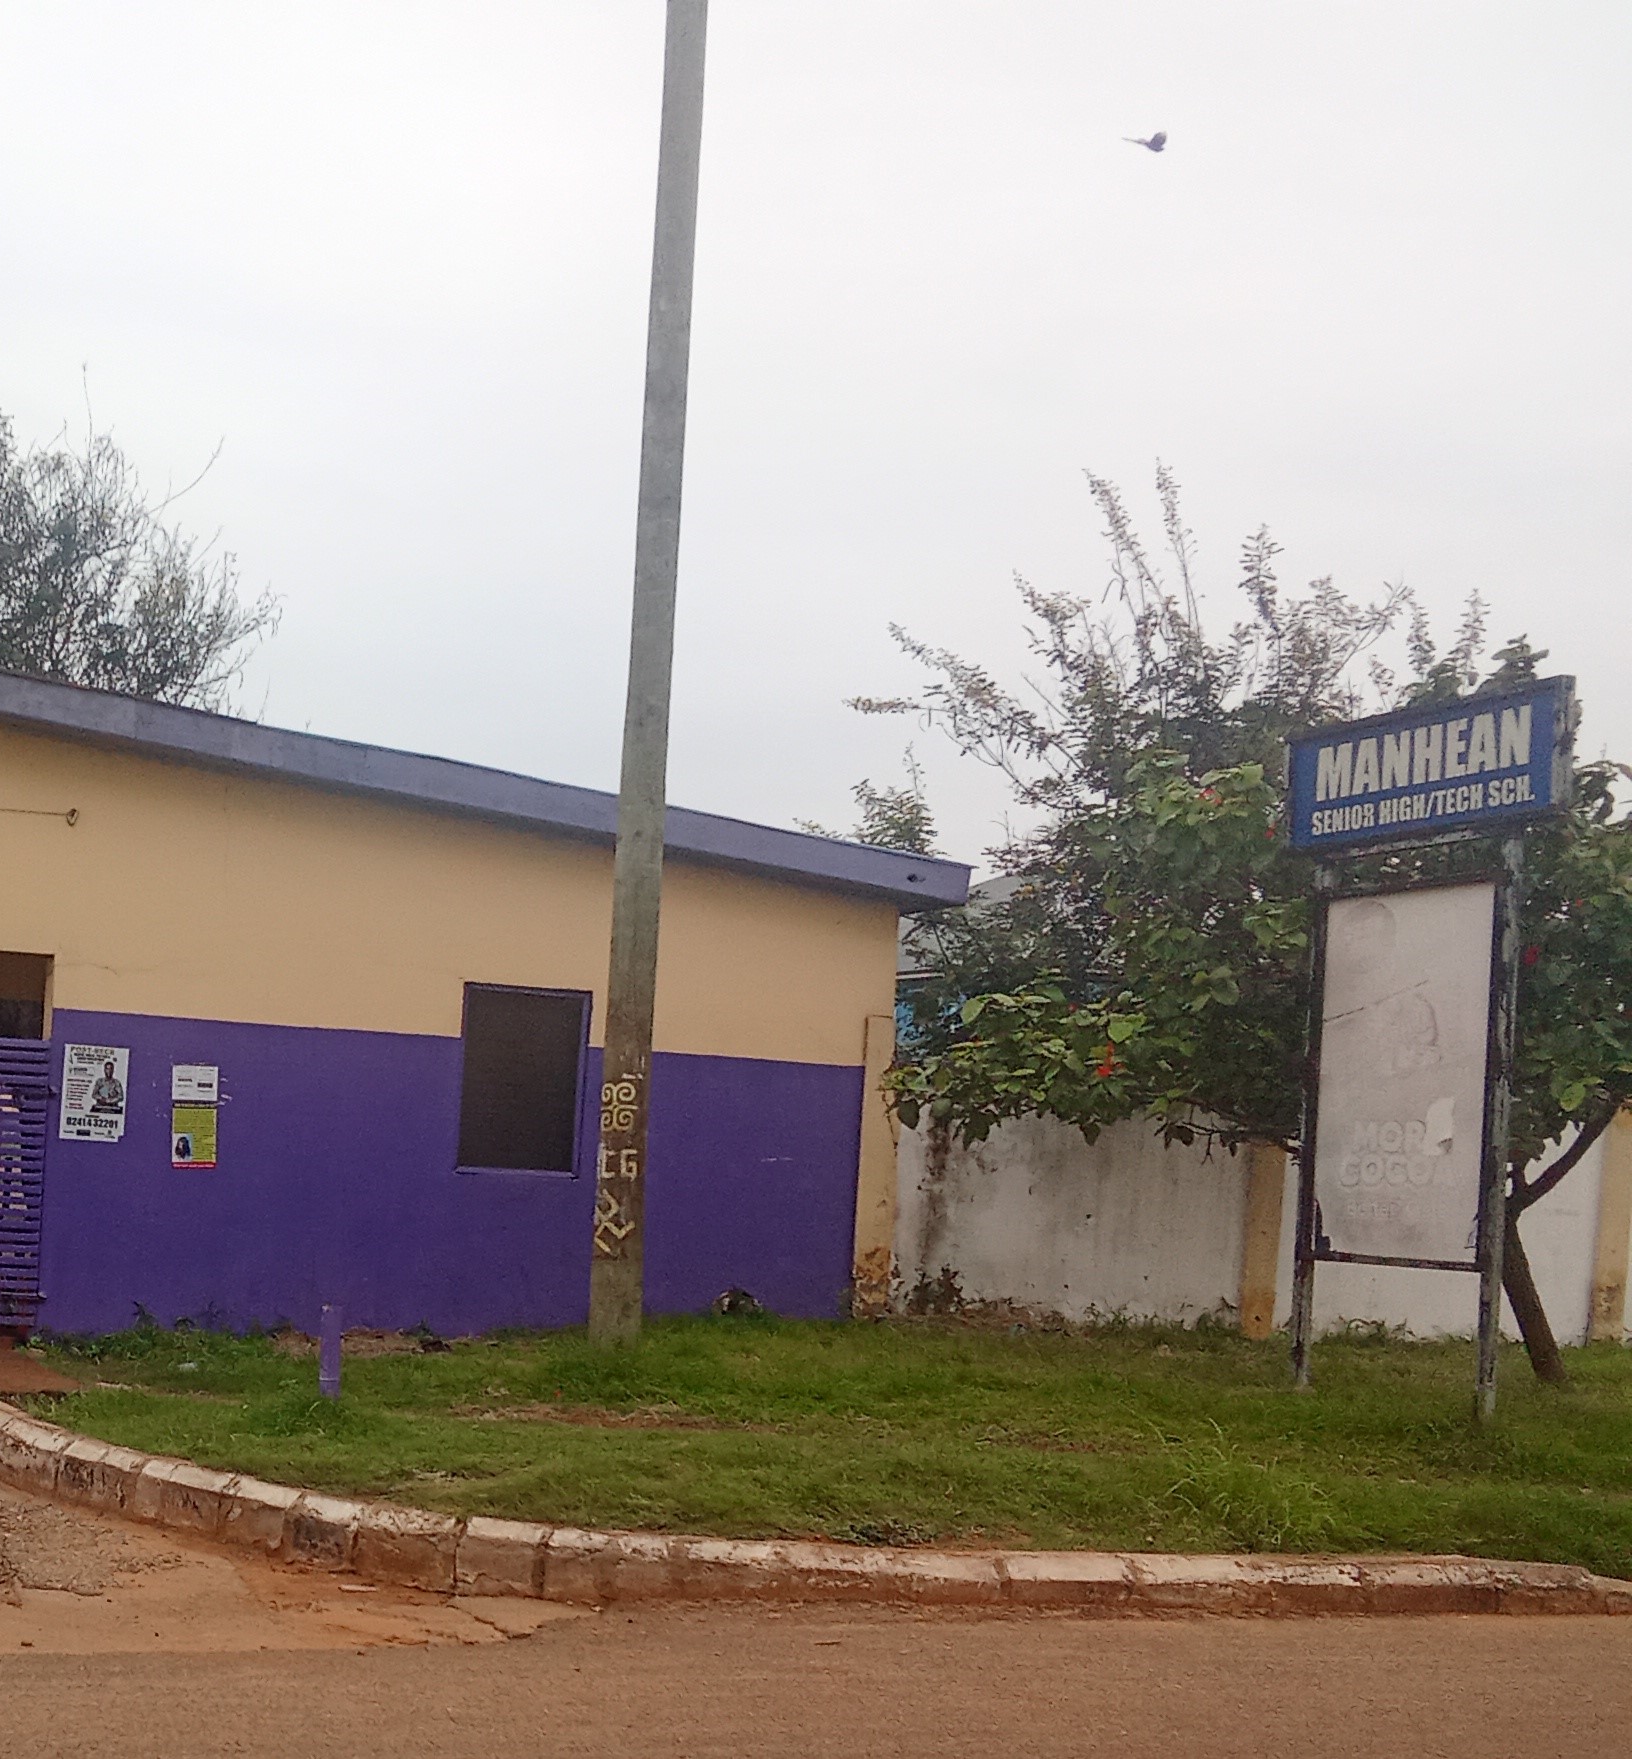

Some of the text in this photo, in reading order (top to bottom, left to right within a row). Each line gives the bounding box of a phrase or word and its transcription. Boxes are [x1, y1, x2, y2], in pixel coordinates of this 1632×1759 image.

[1315, 704, 1532, 802] MANHEAN
[1311, 801, 1375, 836] SENIOR
[1378, 783, 1483, 825] HIGH/TECH
[66, 1116, 119, 1130] 0241432201
